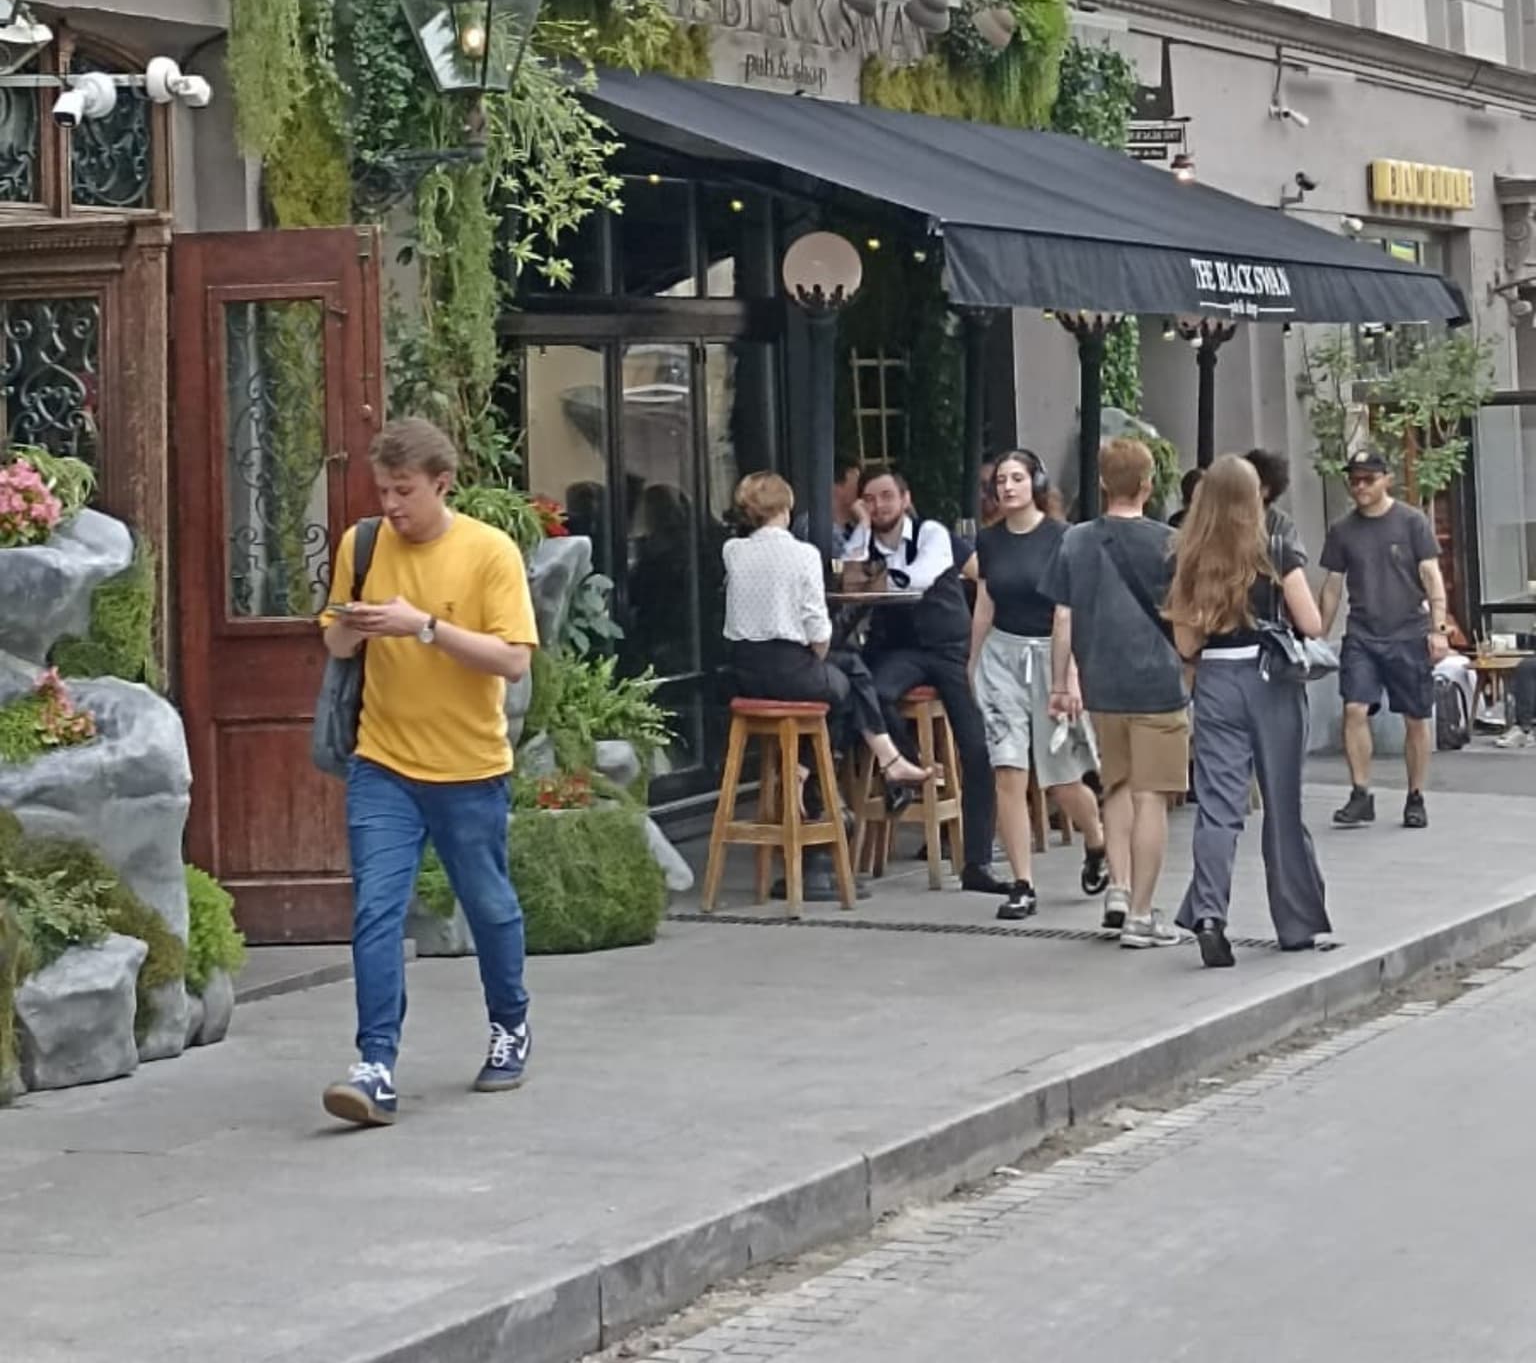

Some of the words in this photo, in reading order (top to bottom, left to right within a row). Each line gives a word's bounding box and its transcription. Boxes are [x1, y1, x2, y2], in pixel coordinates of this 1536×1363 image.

[1190, 257, 1216, 291] THE
[1214, 261, 1255, 295] BLACK
[1253, 265, 1292, 297] SWAN
